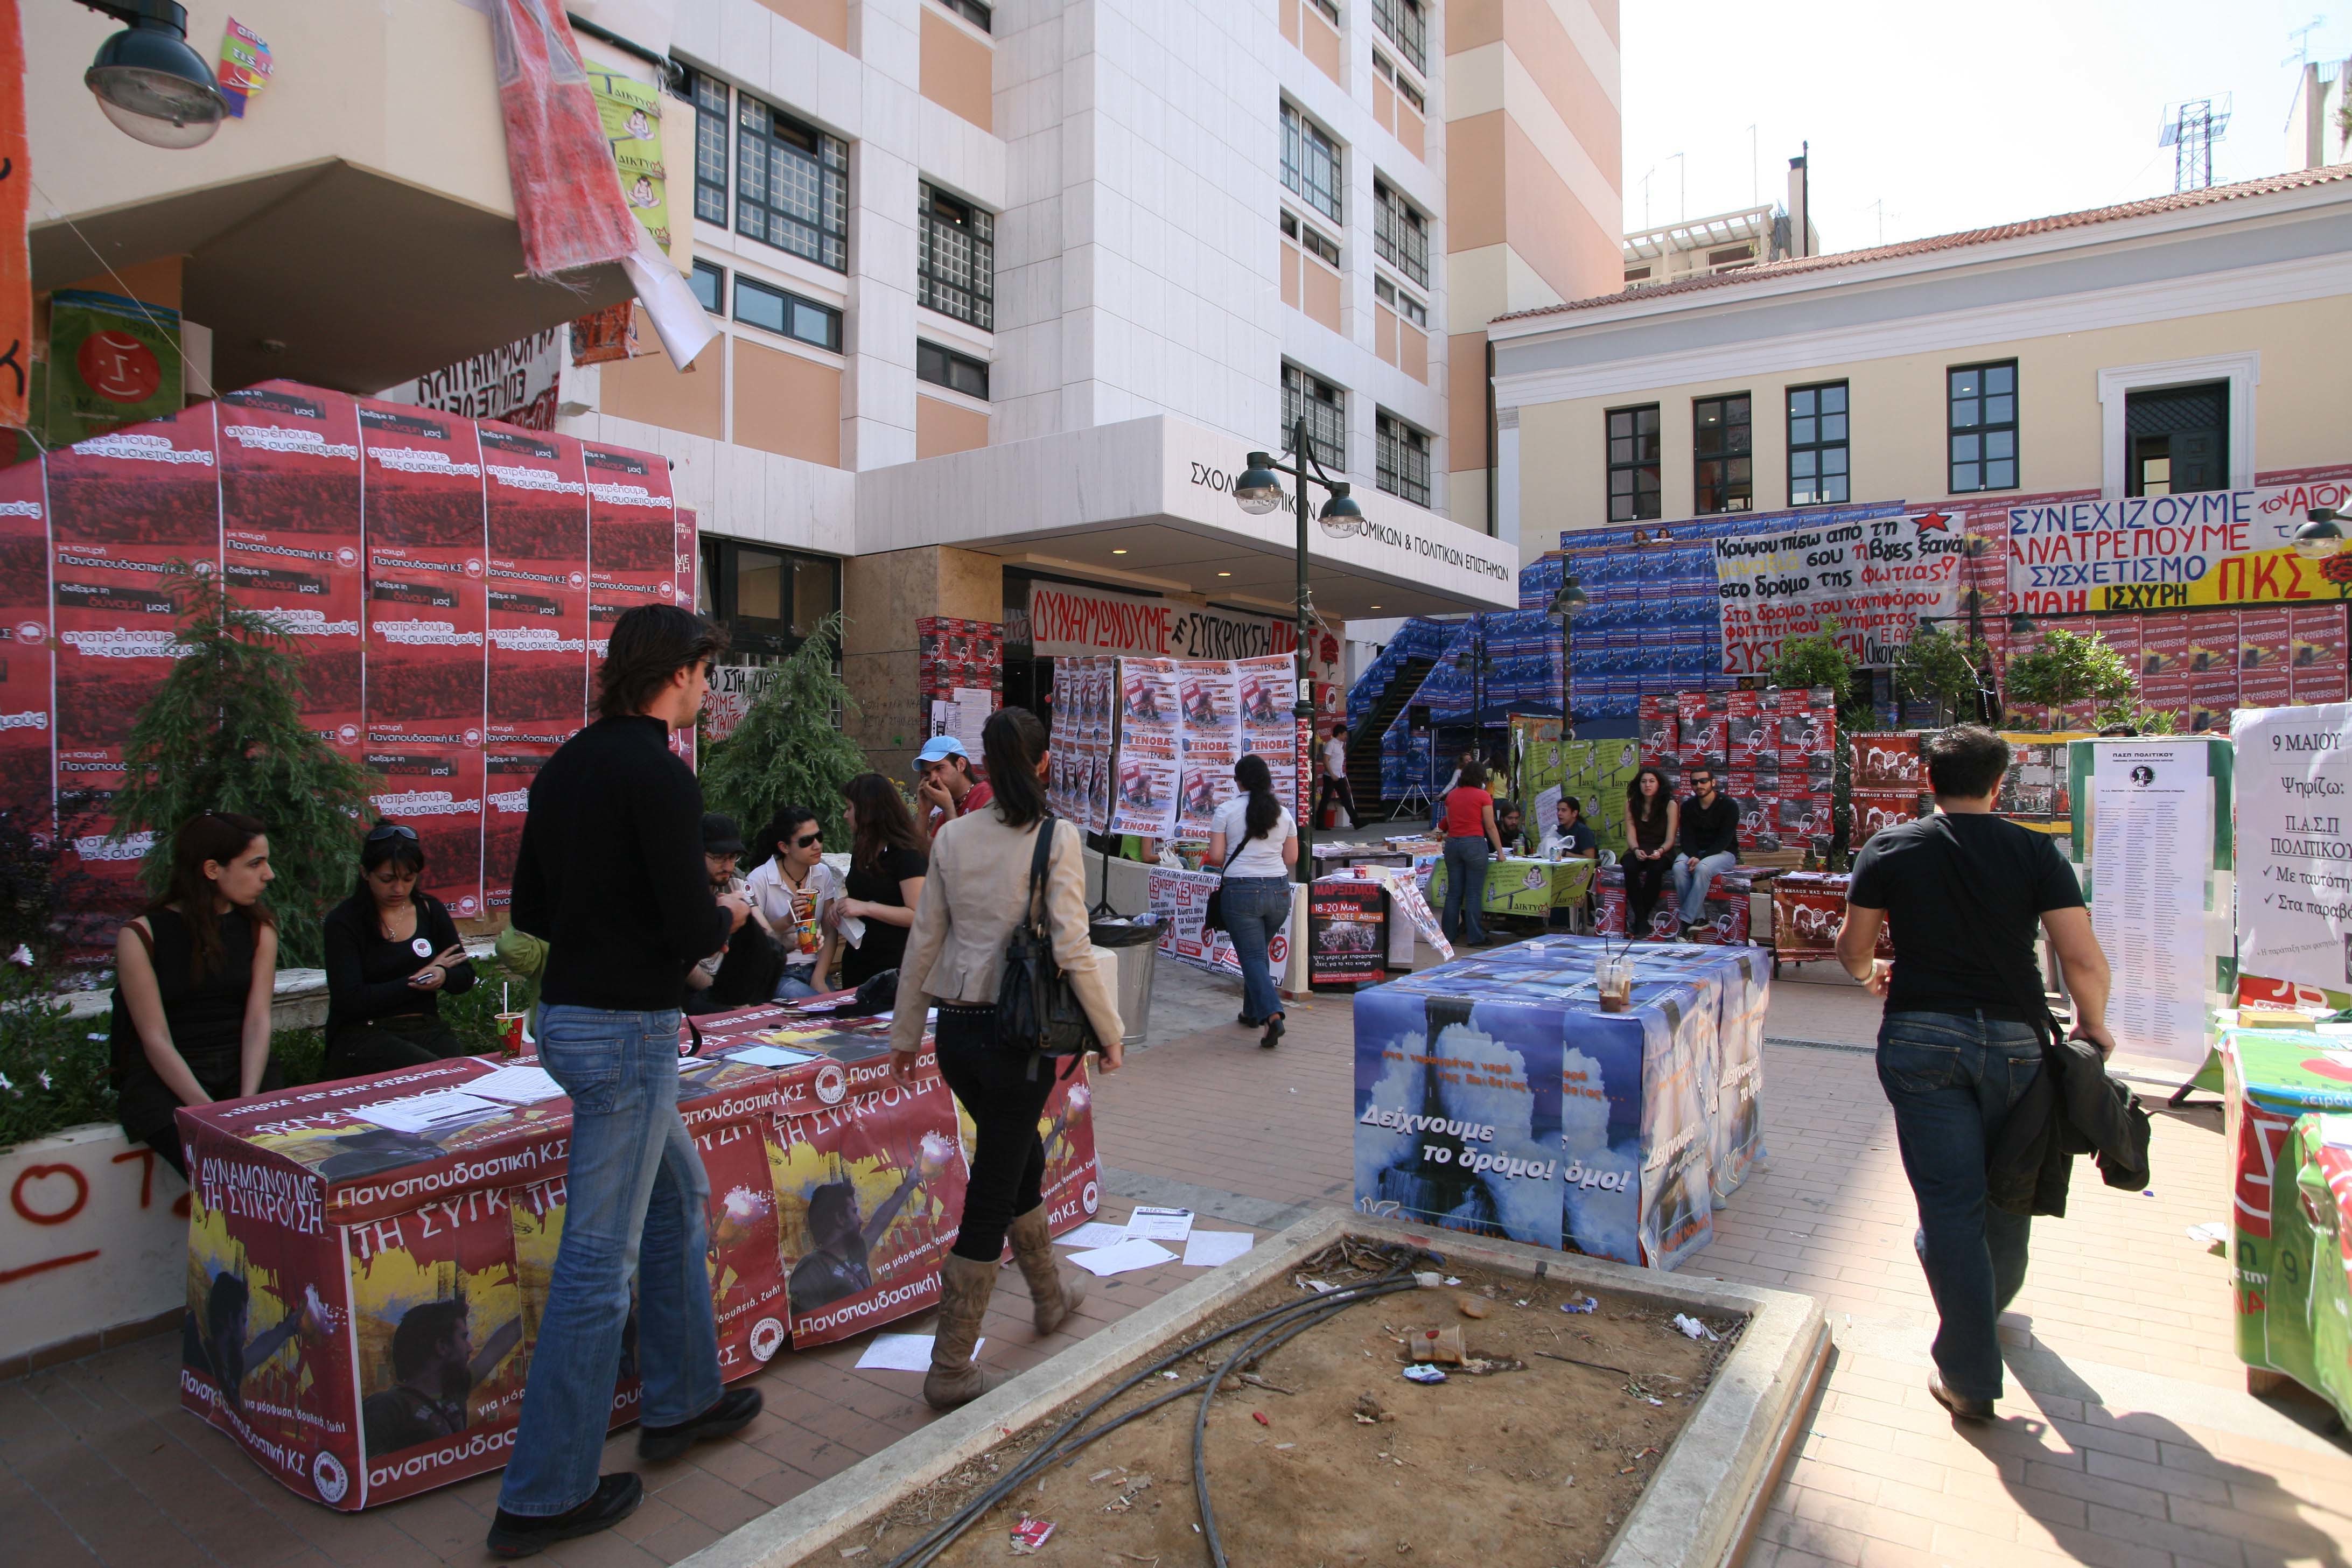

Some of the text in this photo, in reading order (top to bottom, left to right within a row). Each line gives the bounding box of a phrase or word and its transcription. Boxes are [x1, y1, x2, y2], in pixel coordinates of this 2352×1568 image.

[226, 425, 322, 442] ανατρέπουμε
[242, 439, 266, 448] τους
[368, 447, 447, 463] ανατρέπουμε
[381, 460, 401, 469] τους
[487, 465, 556, 480] ανατρέπουμε
[499, 477, 516, 485] τους
[1191, 461, 1509, 582] ΣΧΟΛ & ΠΟΛΙΤΙΚΩΝ ΕΠΙΣΤΗΜΩΝ
[2010, 491, 2255, 535] ΣΥΝΕΧΙΖΟΥΜΕ
[227, 540, 317, 560] Πανσπουδαστική
[1717, 519, 1898, 558] Κρύψου πίσω από τη
[1807, 548, 1843, 566] σου
[1917, 533, 1963, 561] ξανά
[2009, 522, 2251, 565] ΑΝΑΤΡΕΠΟΥΜΕ
[373, 556, 449, 572] Πανσπουδαστική
[2031, 555, 2206, 587] ΣΥΣΧΕΤΙΣΜΟ
[1719, 580, 1751, 598] στο
[1755, 573, 1809, 598] δρόμο
[1817, 569, 1852, 588] της
[2024, 589, 2087, 613] ΜΑΗ
[2105, 583, 2187, 610] ΙΣΧΥΡΗ
[2219, 553, 2311, 600] ΠΚΣ
[1723, 604, 1751, 623] Στο
[1757, 600, 1805, 626] δρόμο
[1811, 599, 1842, 615] του
[374, 619, 453, 633] ανατρέπουμε
[1725, 616, 1820, 641] φοιτητικού
[1146, 665, 1174, 673] ΓΕΝΟΒΑ
[1261, 662, 1291, 671] ΓΕΝΟΒΑ
[1130, 736, 1171, 746] ΓΕΝΟΒΑ
[1189, 741, 1229, 751] ΓΕΝΟΒΑ
[1250, 740, 1289, 750] ΓΕΝΟΒΑ
[2272, 733, 2342, 751] 9 ΜΑΙΟΥ
[2281, 777, 2344, 799] Ψηφίζω:
[1120, 820, 1158, 832] ΓΕΝΟΒΑ
[2276, 866, 2352, 893] Με ταυτότη
[1315, 904, 1338, 912] 18-20
[2278, 895, 2303, 912] Στα
[774, 1117, 807, 1150] ΤΗ
[1360, 1104, 1495, 1142] Δείχνουμε
[1423, 1144, 1557, 1181] το δρόμο!
[202, 1157, 321, 1202] ΔΥΝΑΜΩΝΟΥΜΕ
[338, 1146, 536, 1209] Πανσπουδαστική
[202, 1181, 324, 1234] ΤΗ ΣΥΓΚΡΟΥΣΗ
[351, 1217, 404, 1259] ΤΗ
[799, 1275, 936, 1336] Πανσπουδαστική
